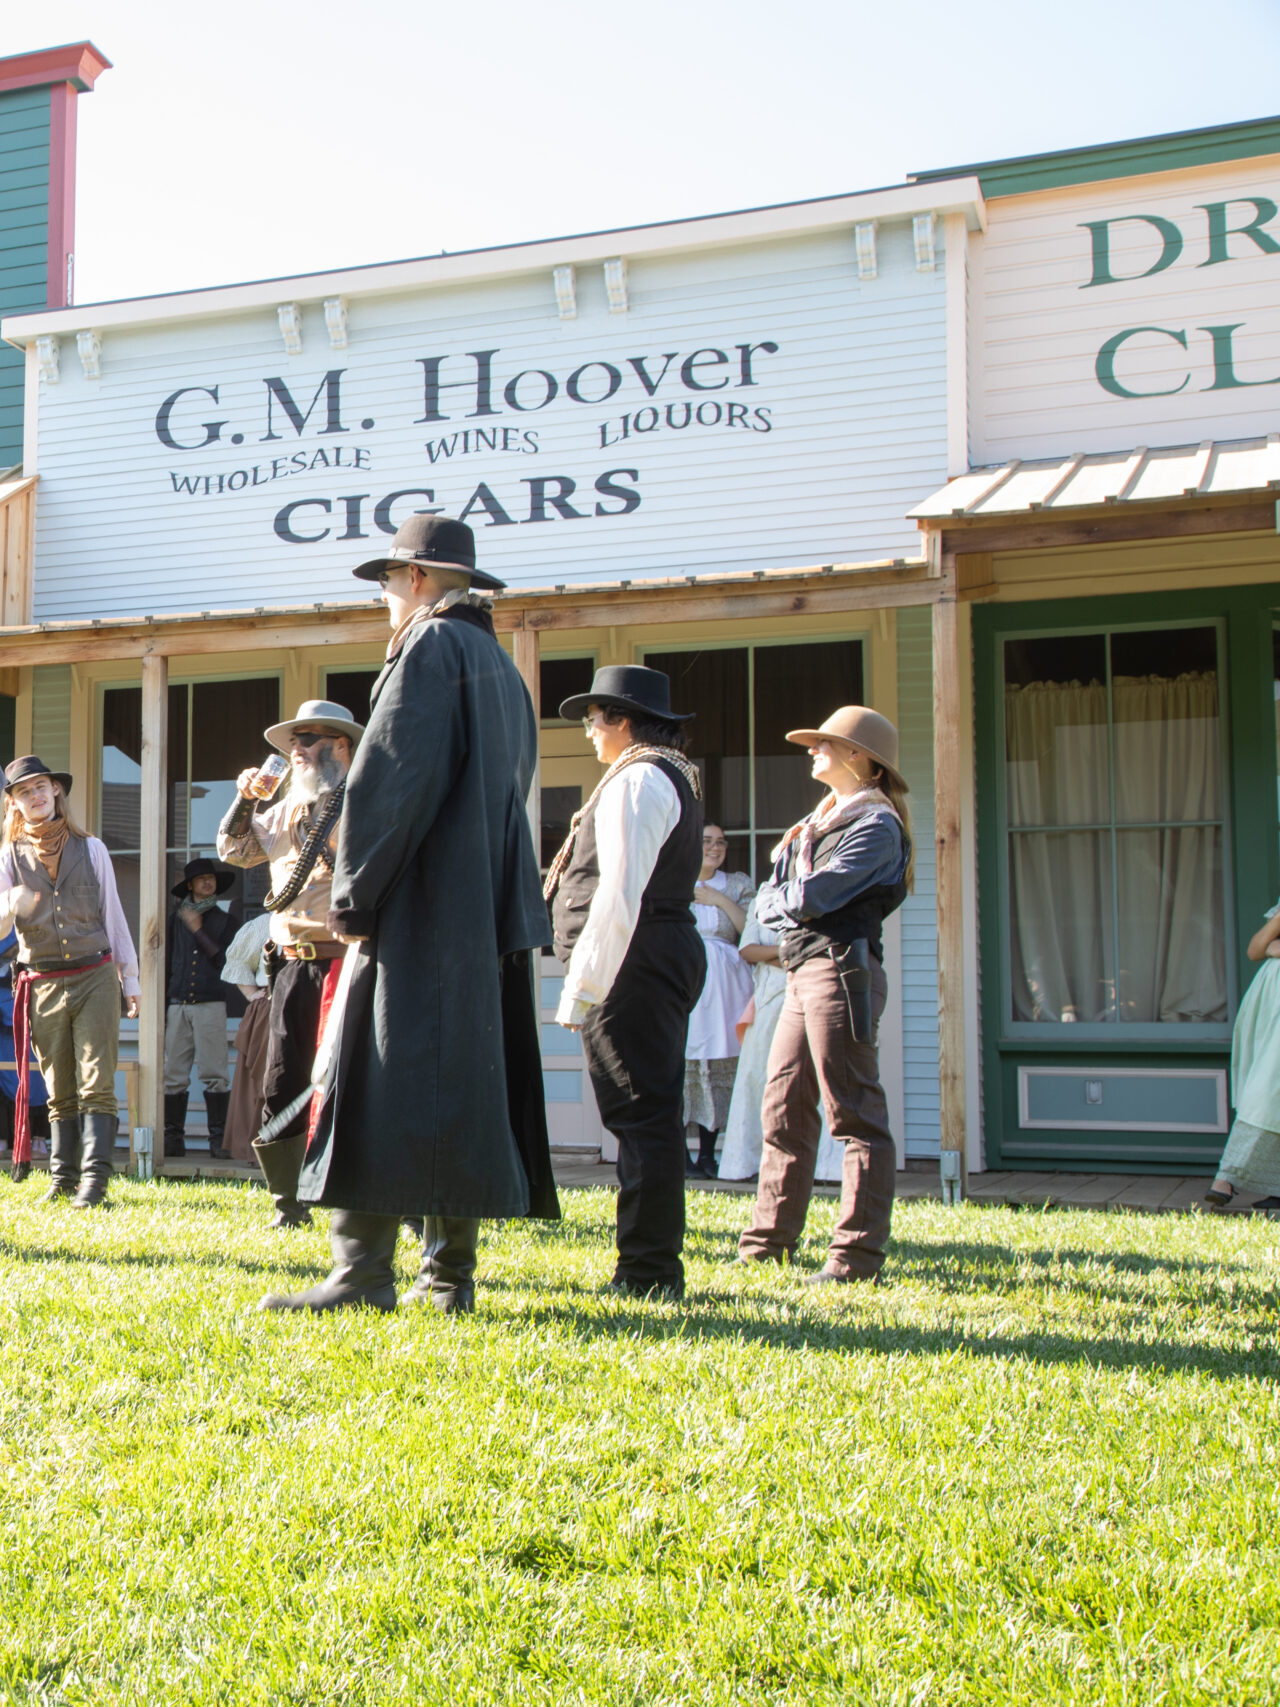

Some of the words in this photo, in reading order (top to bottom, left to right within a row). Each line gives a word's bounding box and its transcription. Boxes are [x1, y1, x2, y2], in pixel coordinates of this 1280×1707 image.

[154, 367, 376, 451] G.M.
[412, 340, 780, 425] Hoover
[168, 446, 372, 496] WHOLESALE
[424, 426, 540, 465] WINES
[599, 400, 773, 450] LIQUORS
[272, 467, 642, 544] CIGARS
